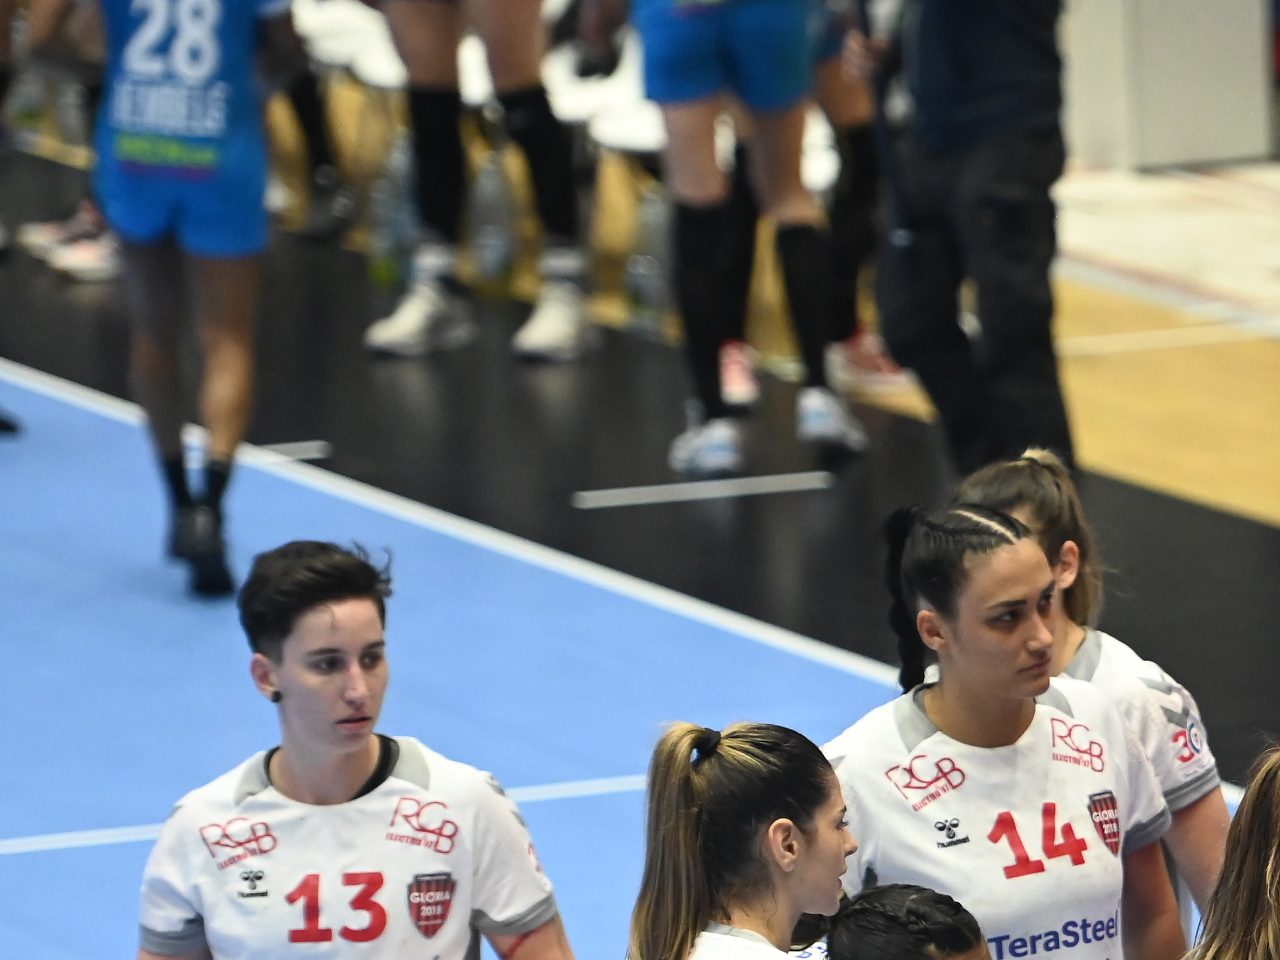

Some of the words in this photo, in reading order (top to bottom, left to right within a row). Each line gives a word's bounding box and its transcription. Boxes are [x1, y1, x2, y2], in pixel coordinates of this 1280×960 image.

[122, 0, 221, 84] 28
[937, 835, 970, 849] hummel
[987, 802, 1089, 879] 14
[285, 872, 388, 943] 13
[409, 890, 452, 905] GLORIA
[988, 908, 1119, 960] TeraSteel
